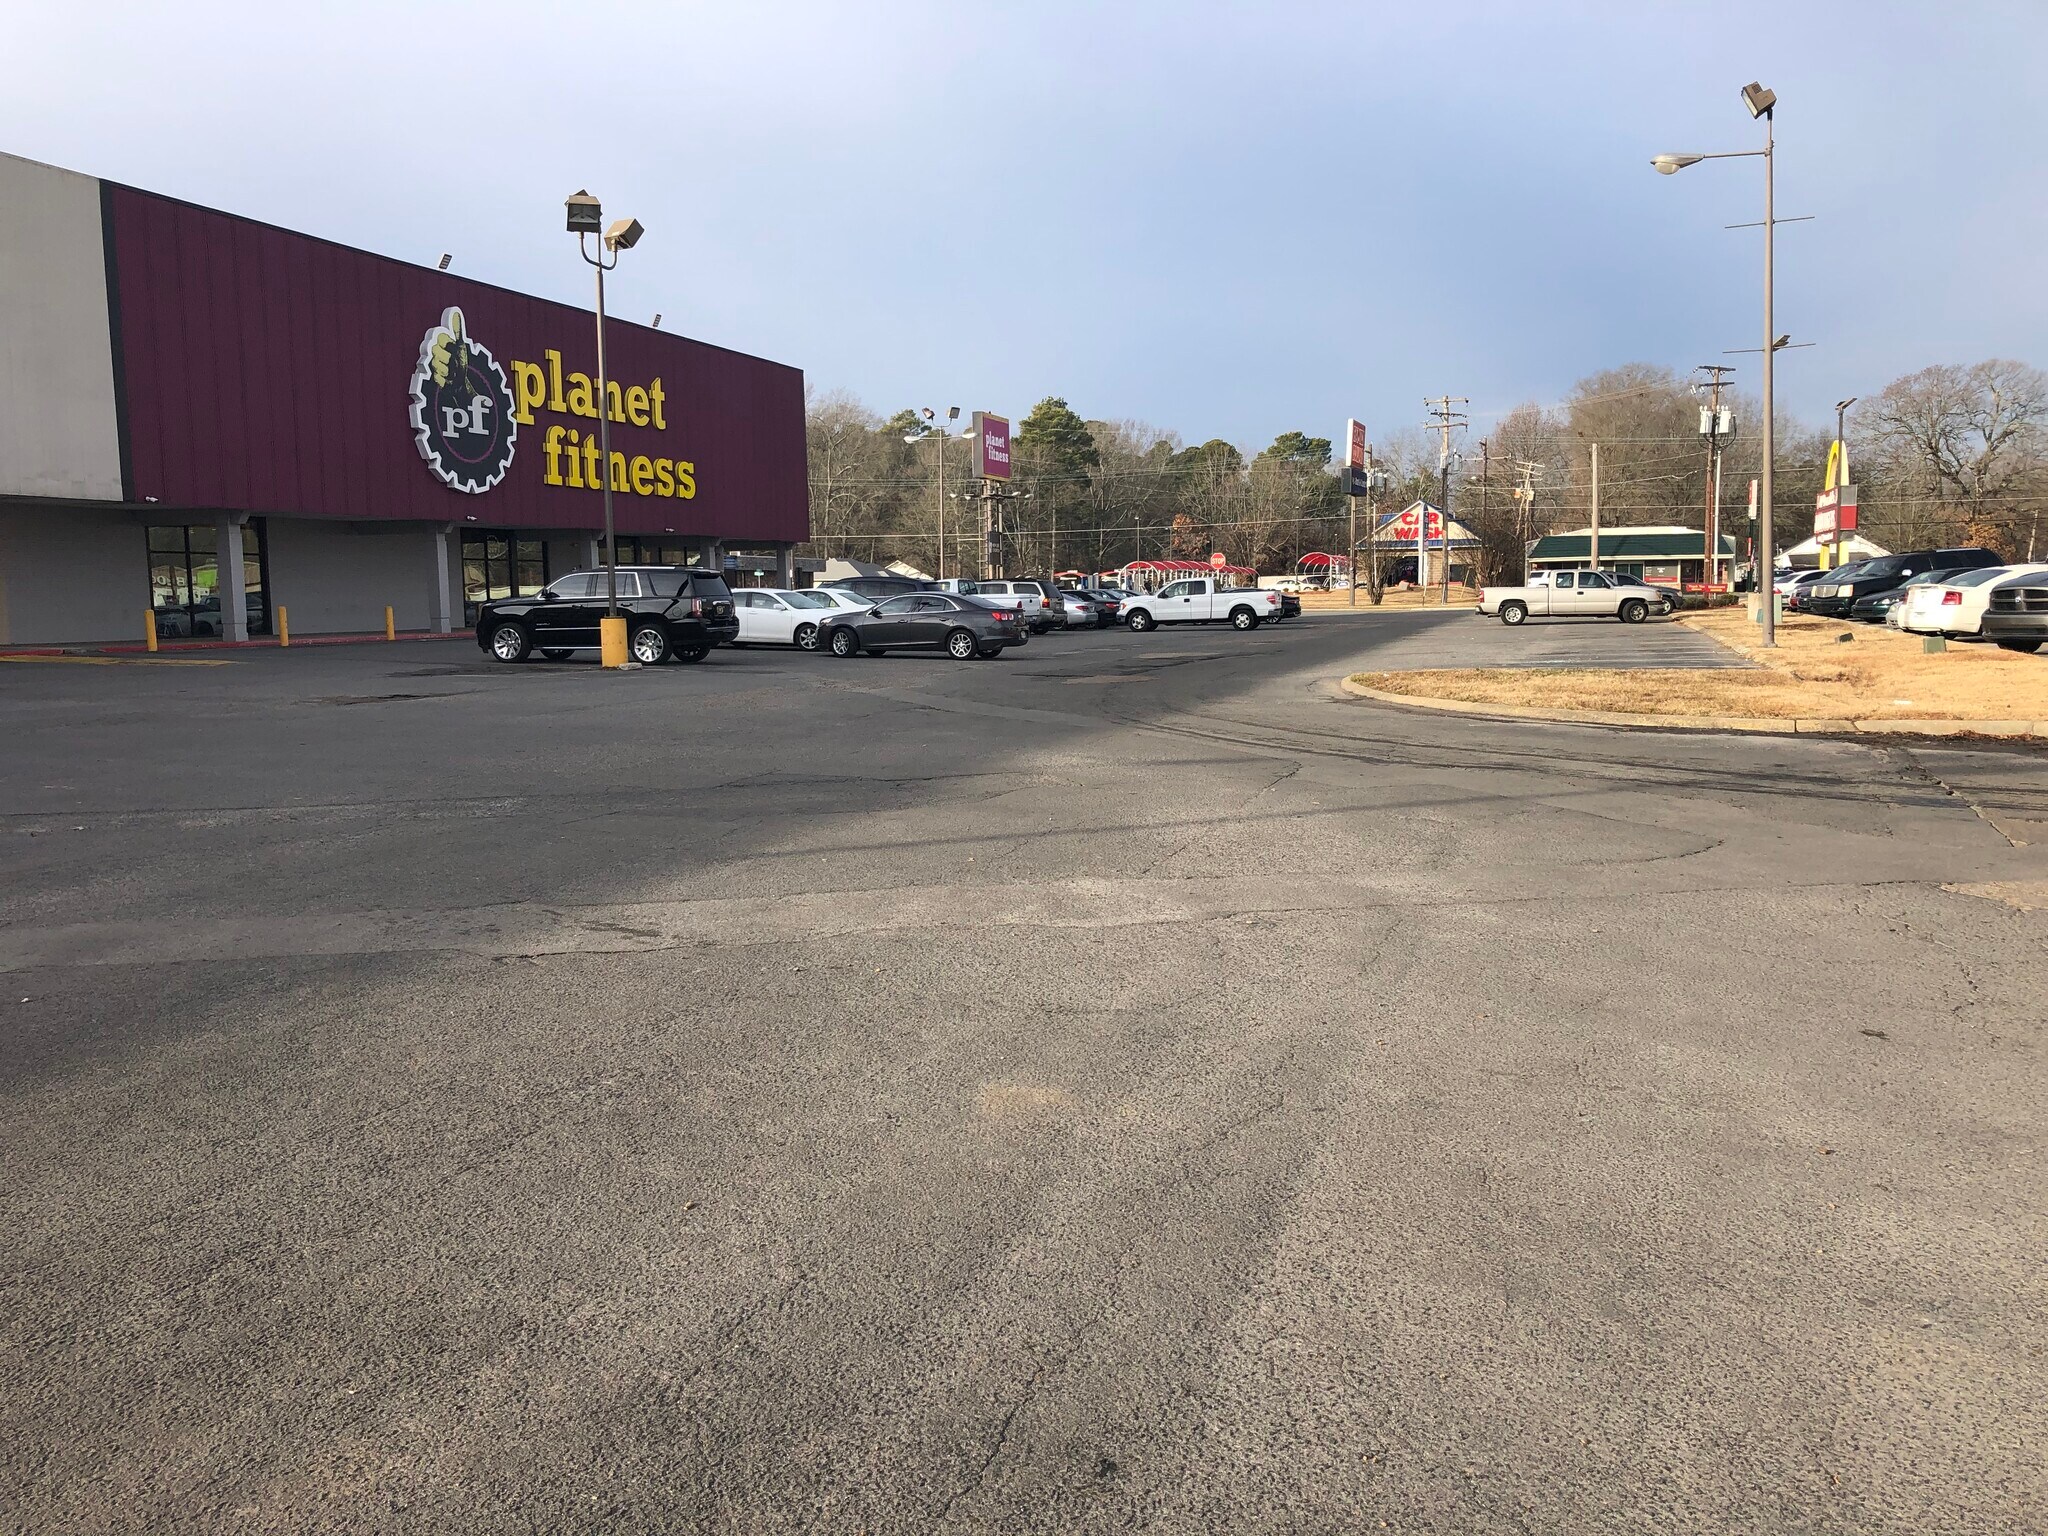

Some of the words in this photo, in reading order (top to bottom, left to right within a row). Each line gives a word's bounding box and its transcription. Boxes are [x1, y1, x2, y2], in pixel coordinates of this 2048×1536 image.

[511, 348, 666, 430] planet
[442, 395, 493, 438] pf
[985, 431, 1004, 448] planet
[988, 446, 1008, 463] fitness
[543, 425, 696, 500] fitness
